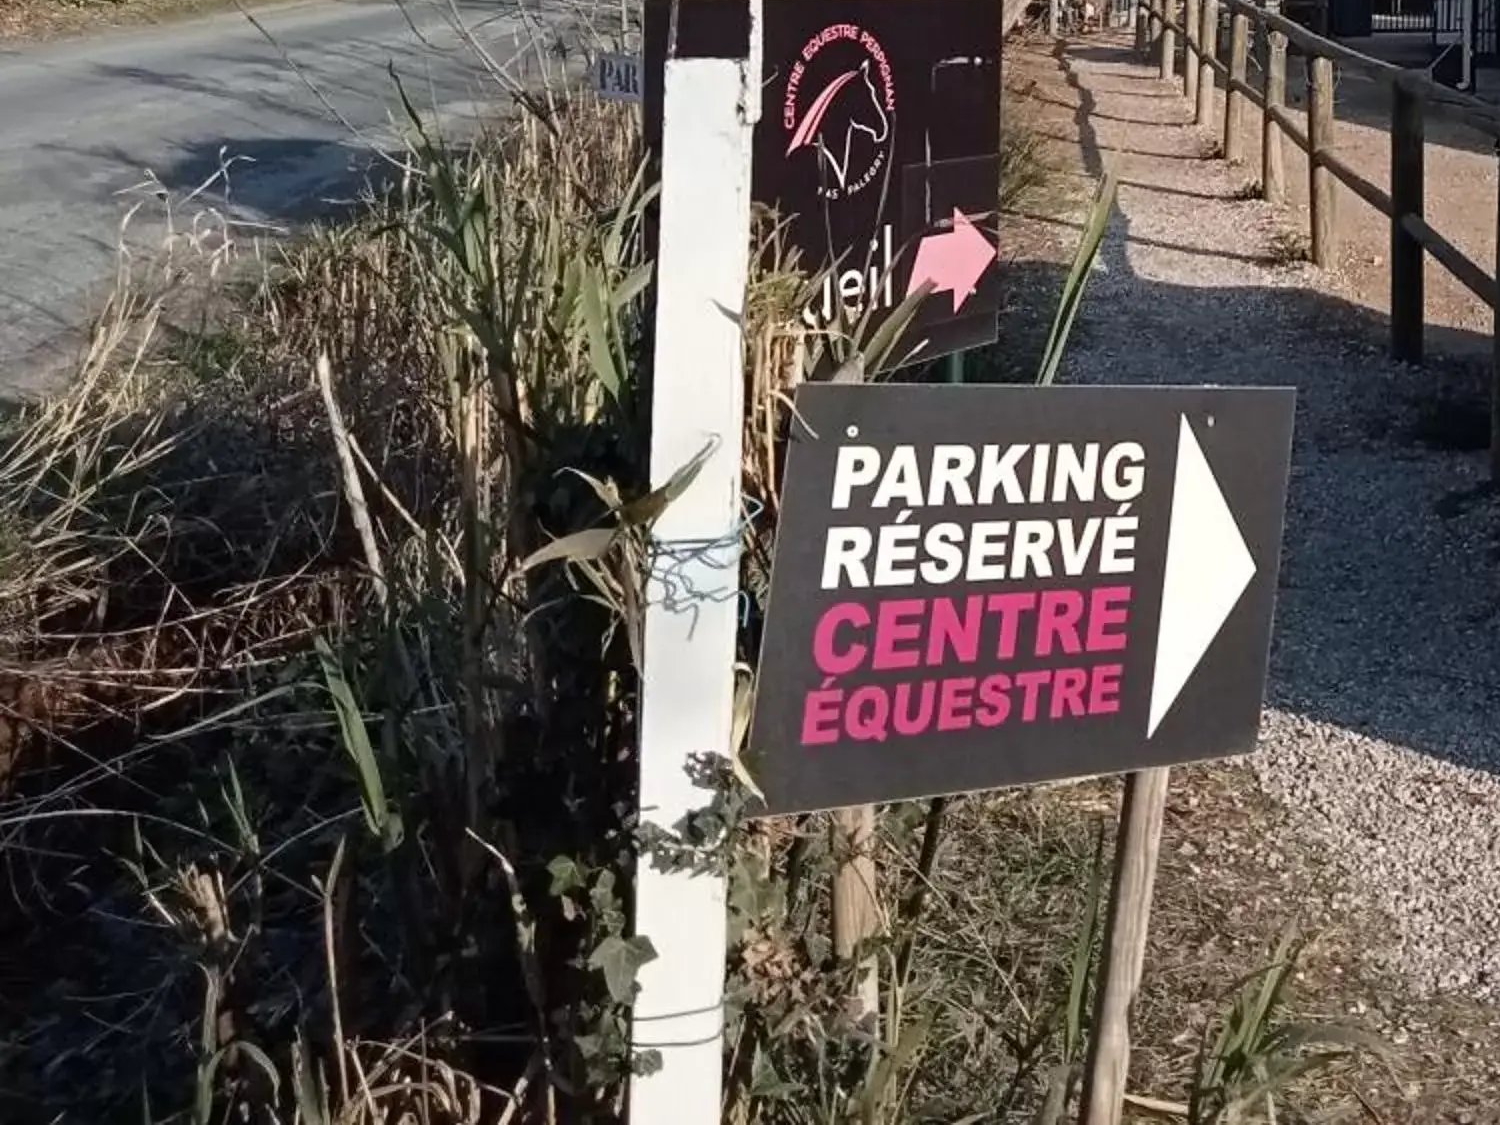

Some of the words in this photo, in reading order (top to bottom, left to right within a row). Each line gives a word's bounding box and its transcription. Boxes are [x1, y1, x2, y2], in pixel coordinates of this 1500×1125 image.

[784, 60, 805, 129] CENTRE
[802, 24, 860, 62] EQUESTRE
[831, 442, 1146, 510] PARKING
[820, 502, 1140, 589] RÉSERVÉ
[812, 586, 1132, 675] CENTRE
[801, 664, 1124, 746] ÉQUESTRE
